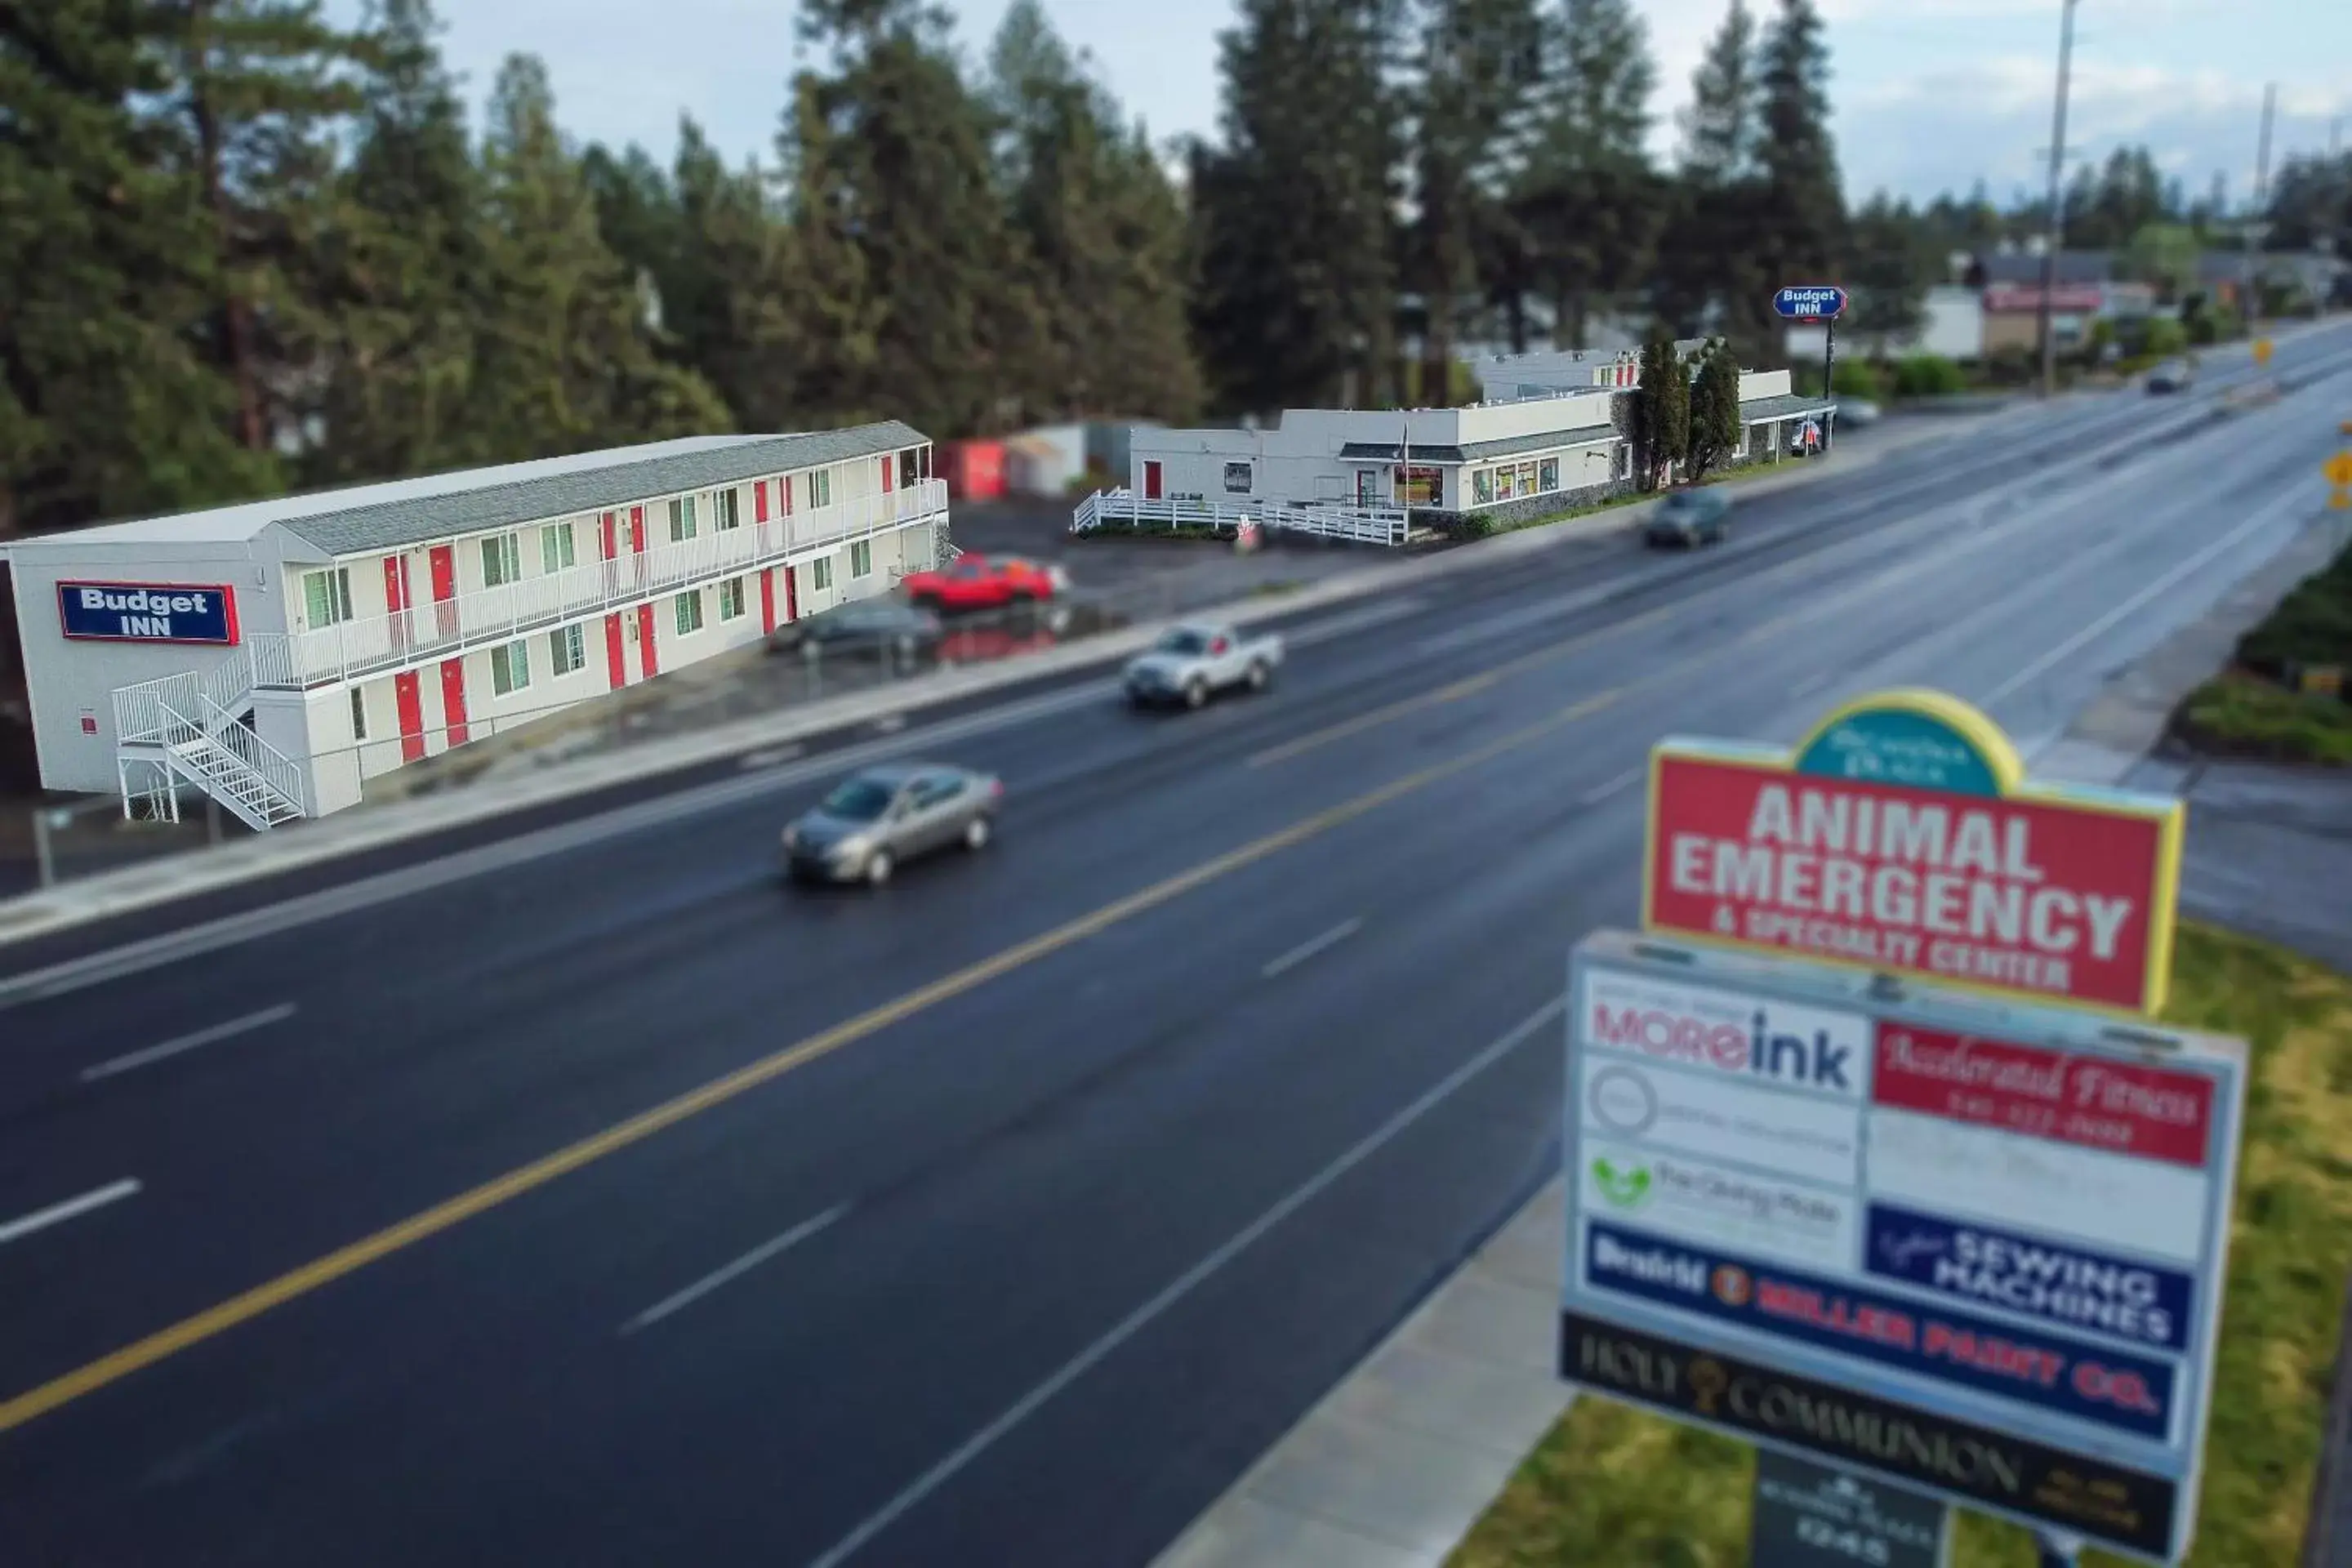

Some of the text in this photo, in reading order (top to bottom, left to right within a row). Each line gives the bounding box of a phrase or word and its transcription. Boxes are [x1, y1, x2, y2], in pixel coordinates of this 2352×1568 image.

[1784, 289, 1836, 303] Budget
[1795, 303, 1822, 314] INN
[80, 588, 208, 616] Budget
[121, 615, 172, 636] INN
[1747, 783, 2045, 883] ANIMAL
[1669, 833, 2133, 960] EMERGENCY
[1711, 904, 2072, 991] & SPECIALTY CENTER
[2073, 1065, 2198, 1125] Fitness
[1934, 1255, 2172, 1342] MACHINES
[1953, 1230, 2158, 1304] SEWING
[1757, 1279, 1915, 1350] MILLER
[1922, 1321, 2065, 1386] PAINT
[2072, 1361, 2160, 1416] CO.
[1580, 1333, 2021, 1492] HOLY COMMUNION
[1797, 1515, 1891, 1566] 1245
